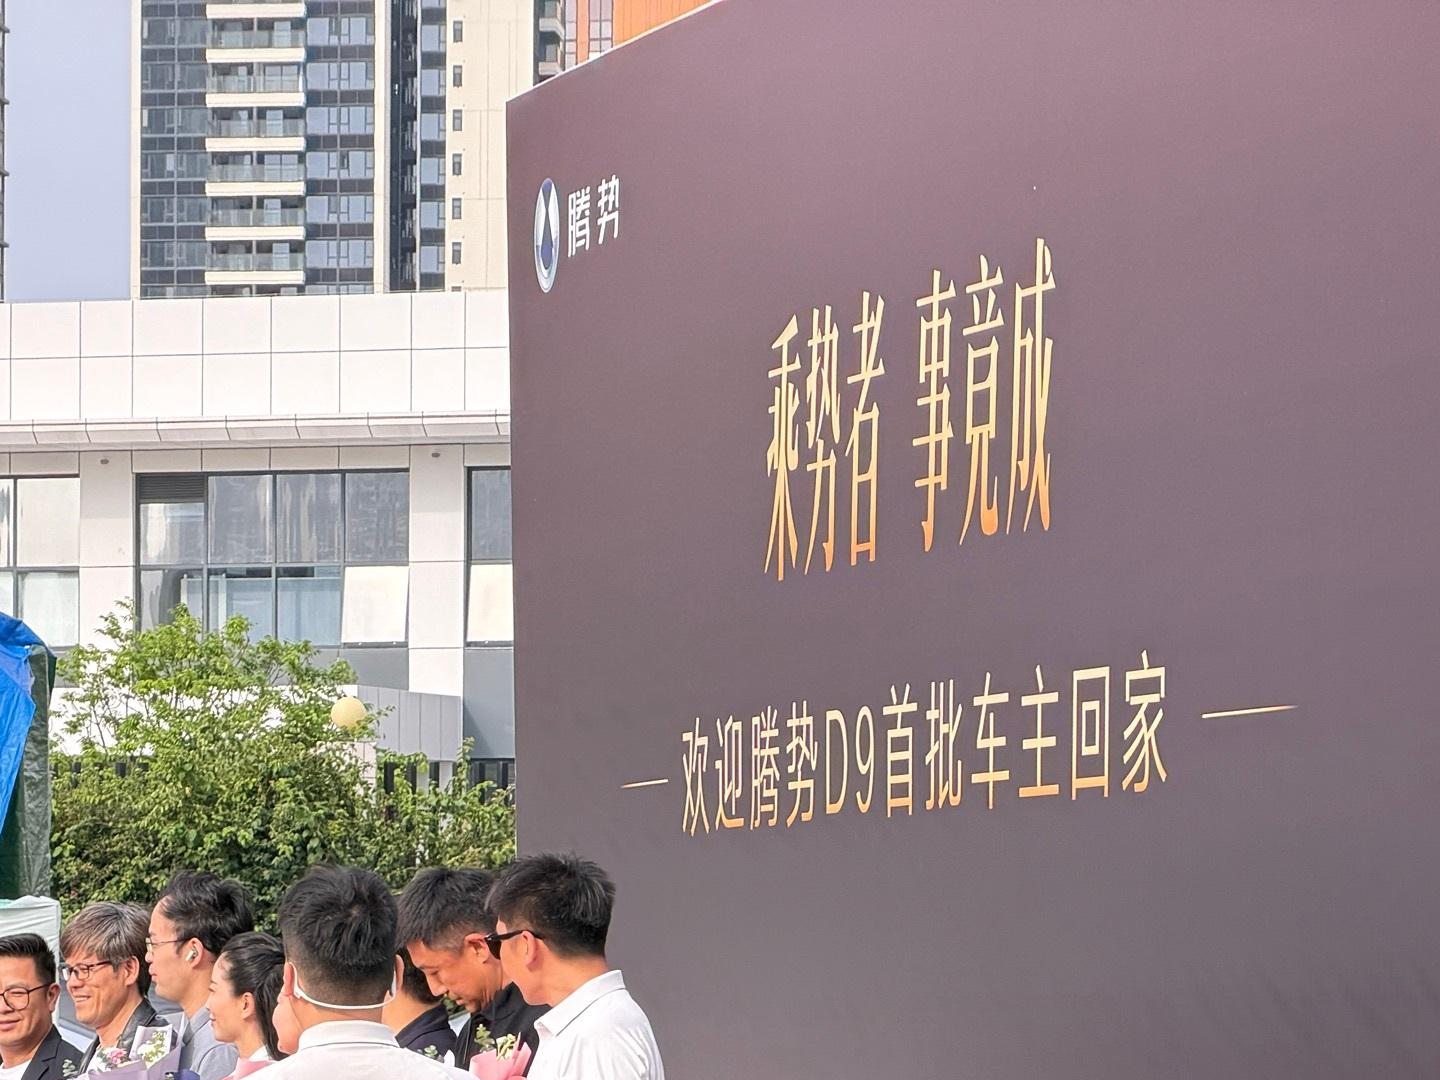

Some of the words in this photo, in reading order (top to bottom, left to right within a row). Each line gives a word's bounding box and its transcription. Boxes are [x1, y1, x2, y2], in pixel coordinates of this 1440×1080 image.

[567, 174, 621, 258] 腾势
[764, 290, 885, 582] 乘势者
[913, 237, 1057, 552] 事竟成
[681, 650, 1168, 836] 欢迎腾势D9首批车主回家
